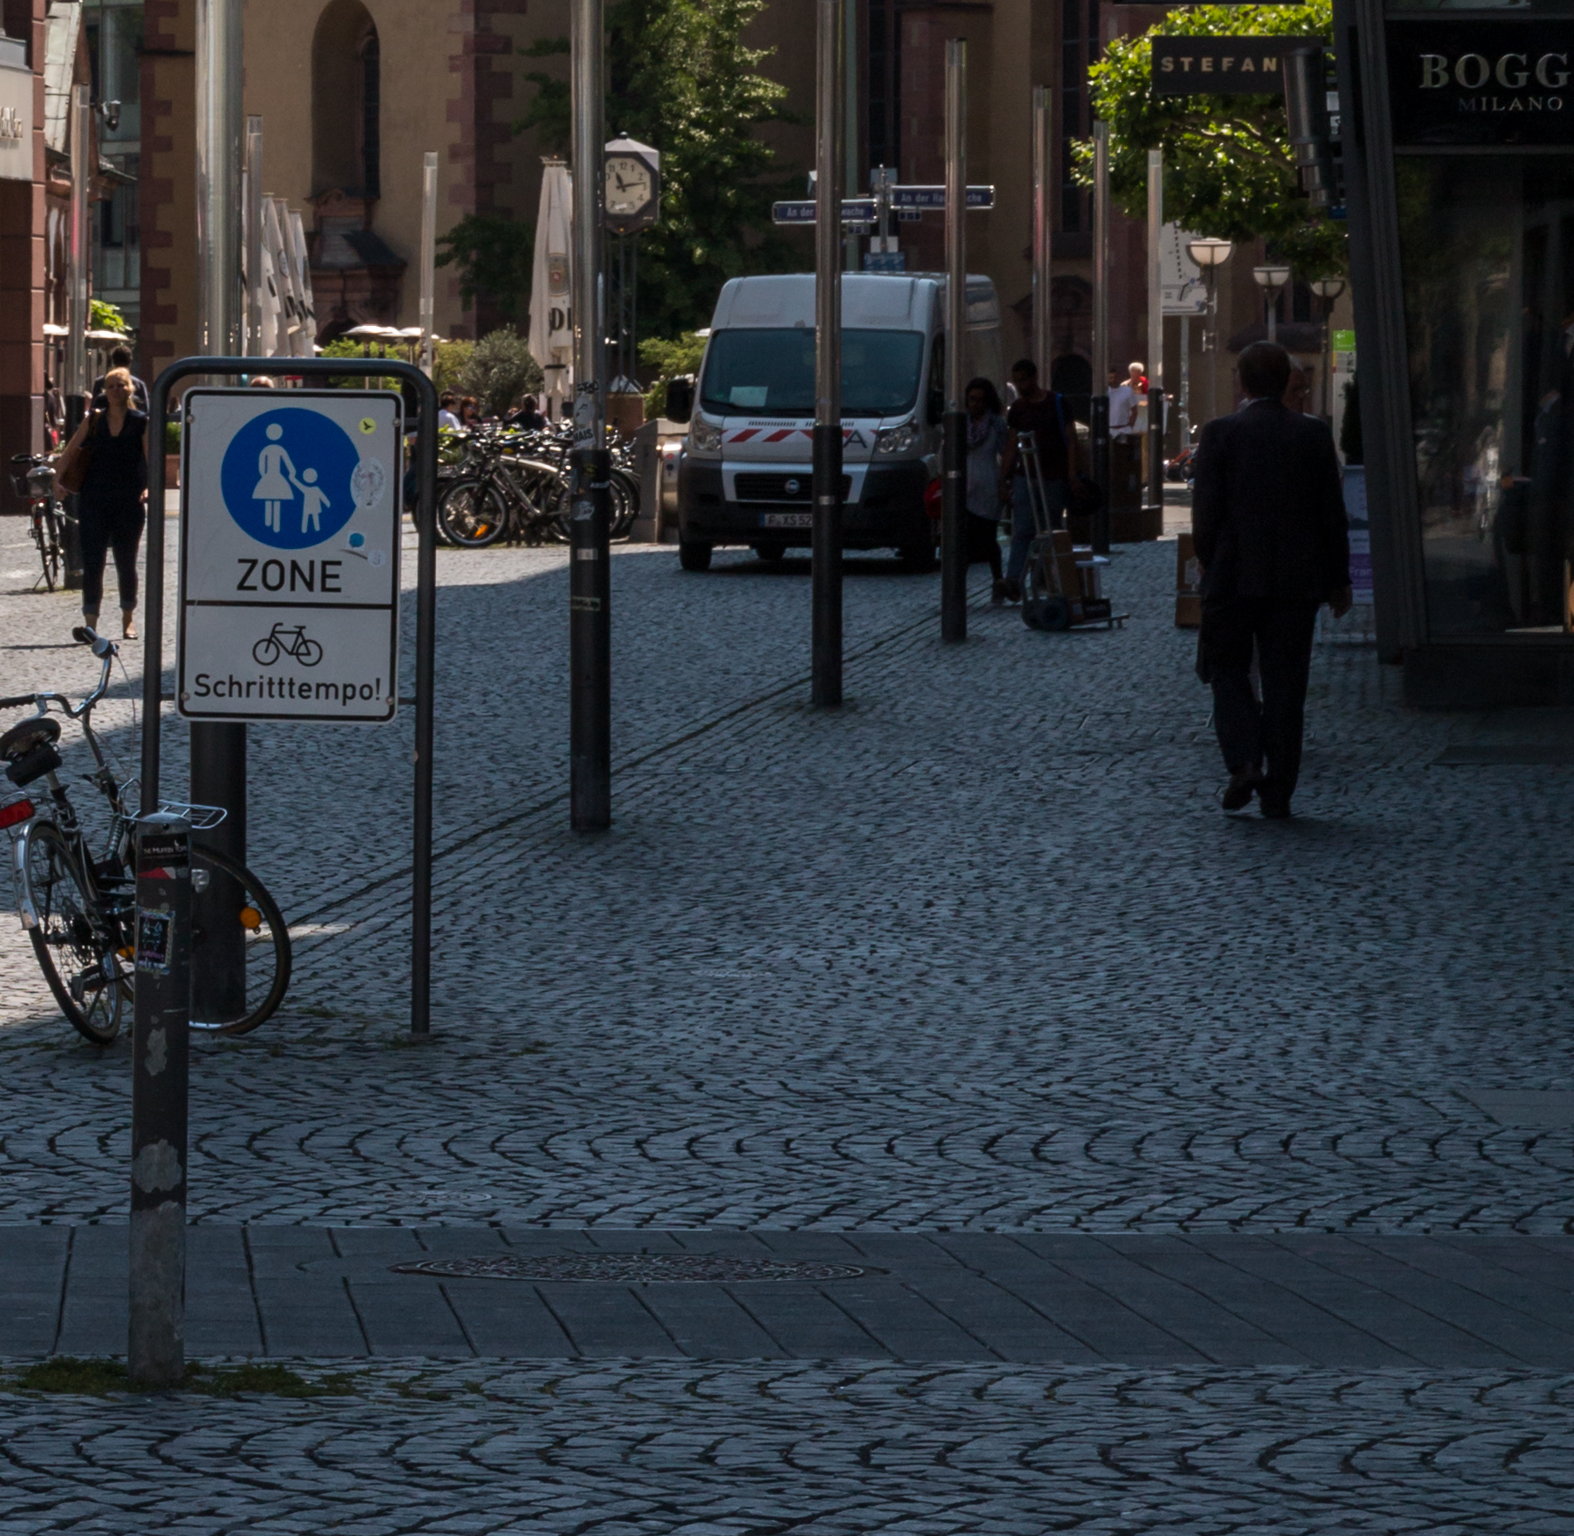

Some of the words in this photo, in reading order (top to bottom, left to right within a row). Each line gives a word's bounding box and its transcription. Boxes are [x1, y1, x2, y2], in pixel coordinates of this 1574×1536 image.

[1419, 52, 1572, 89] BOGG
[1458, 96, 1564, 112] MILANO
[236, 558, 342, 593] ZONE
[194, 673, 381, 706] Schritttempo!
